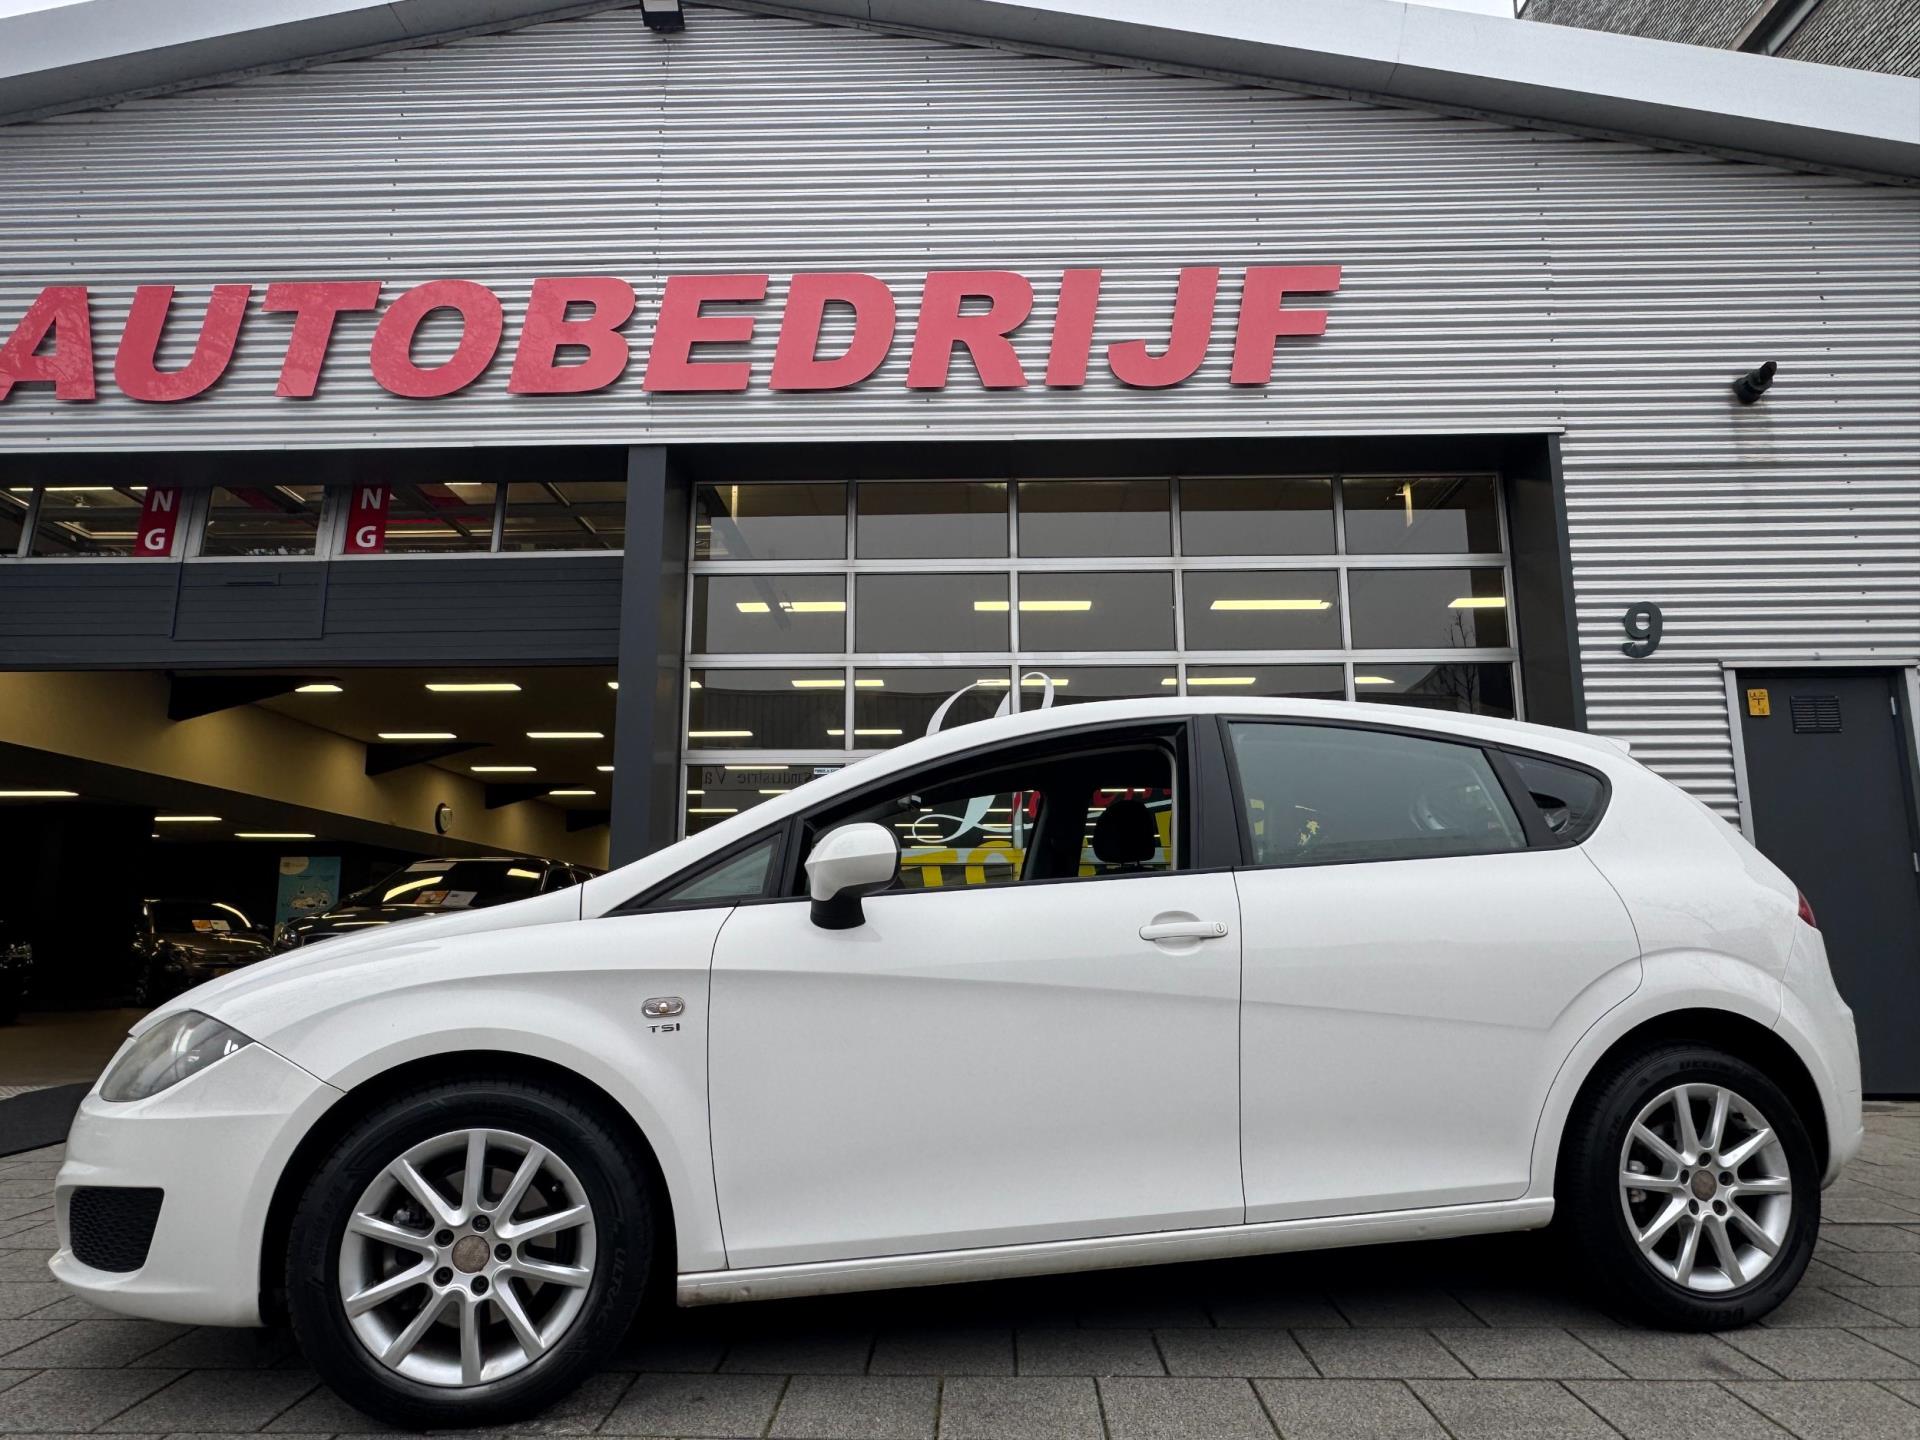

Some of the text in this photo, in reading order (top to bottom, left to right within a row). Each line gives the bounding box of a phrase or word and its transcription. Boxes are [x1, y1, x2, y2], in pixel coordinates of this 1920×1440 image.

[0, 265, 1342, 401] AUTOBEDRIJF
[1621, 601, 1663, 658] 9
[647, 1022, 681, 1034] TSI
